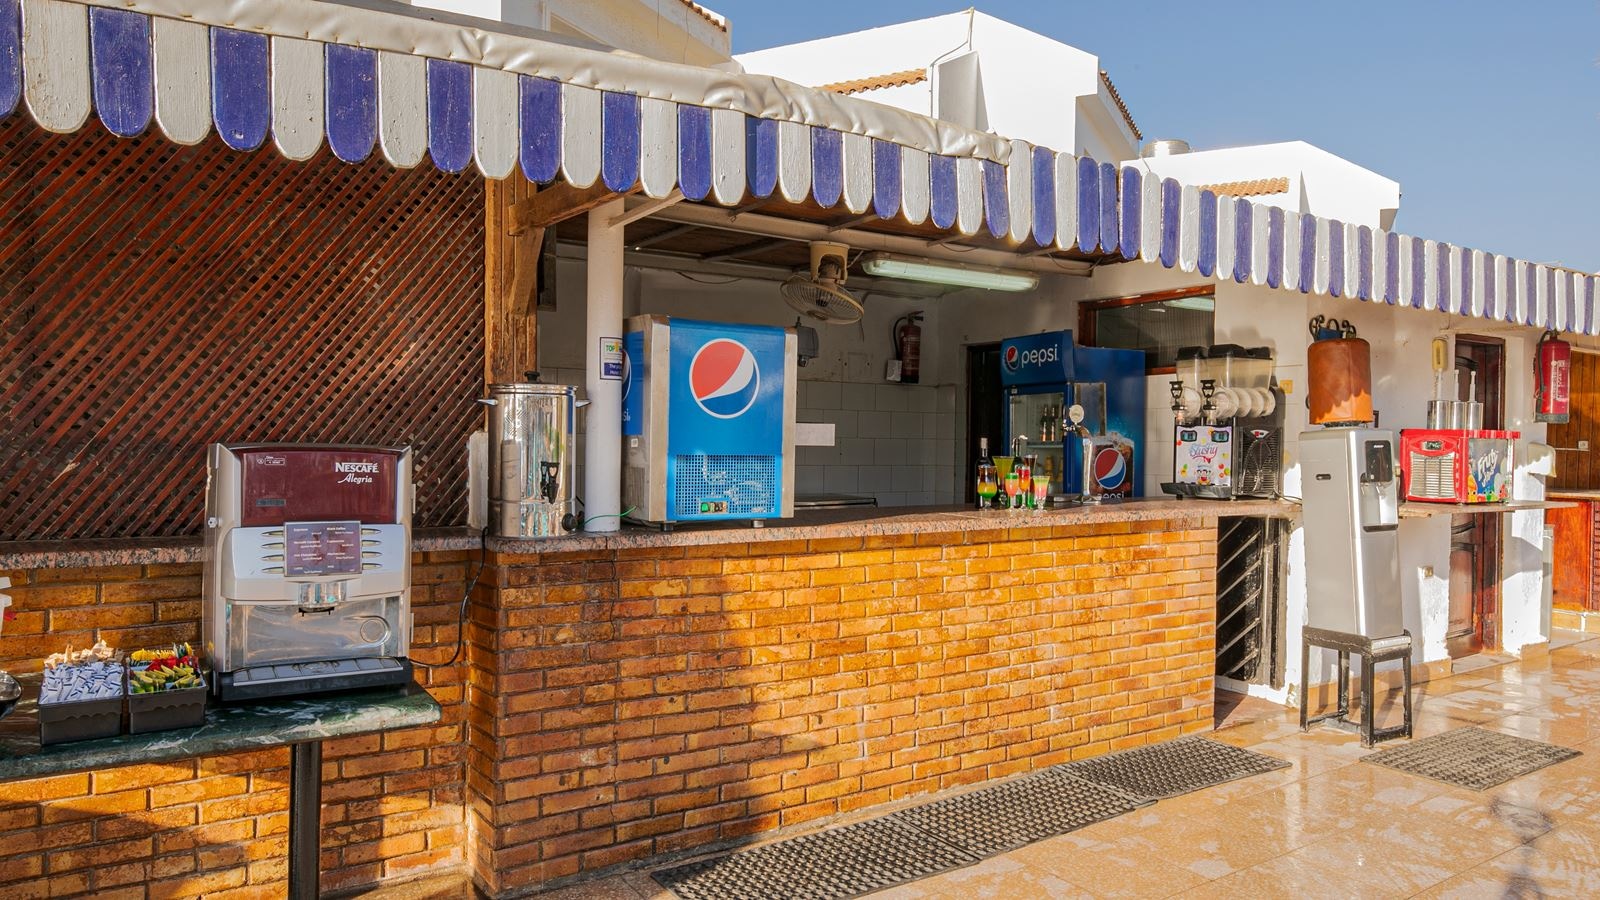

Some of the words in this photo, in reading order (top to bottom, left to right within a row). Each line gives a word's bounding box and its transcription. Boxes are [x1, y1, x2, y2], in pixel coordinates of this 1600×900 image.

[1021, 343, 1058, 369] pepsi
[335, 462, 379, 473] NESCAFÉ
[337, 473, 373, 485] Alegria
